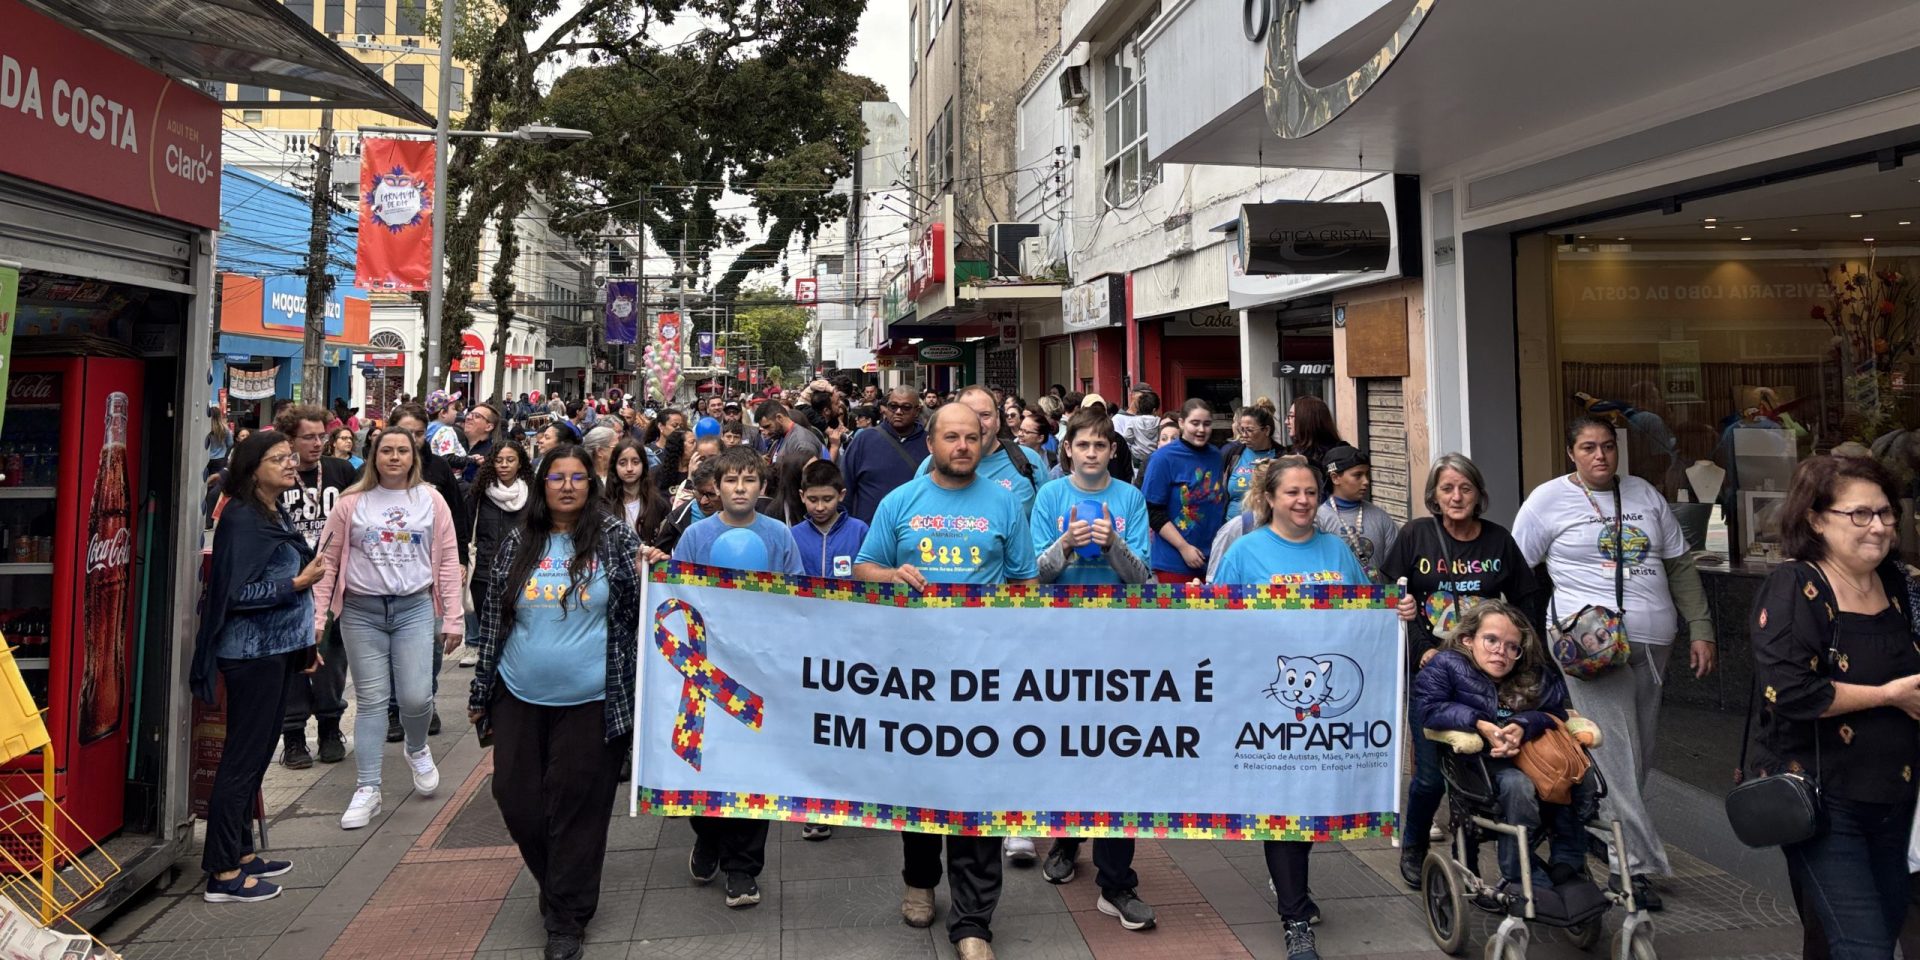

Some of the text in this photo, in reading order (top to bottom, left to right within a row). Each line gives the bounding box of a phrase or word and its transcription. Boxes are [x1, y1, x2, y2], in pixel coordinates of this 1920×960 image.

[1, 54, 138, 154] DA COSTA
[167, 119, 199, 142] AQUI TEM
[165, 144, 209, 184] Claro
[1269, 227, 1372, 242] ÓTICA CRISTAL
[272, 291, 308, 319] Magaz
[1300, 363, 1334, 375] mor
[911, 516, 988, 531] AUTISMO
[1622, 513, 1644, 522] Mãe
[1419, 557, 1431, 575] O
[1272, 570, 1342, 584] AUTISMO
[802, 656, 1213, 703] LUGAR DE AUTISTA É
[813, 712, 1201, 759] EM TODO O LUGAR
[1234, 720, 1392, 751] AMPARHO
[1234, 752, 1276, 762] Associação
[1288, 753, 1320, 762] Autistas,
[1322, 752, 1344, 761] Mães,
[1344, 753, 1361, 761] Pais,
[1362, 751, 1388, 760] Amigos
[1321, 763, 1352, 772] Enfoque
